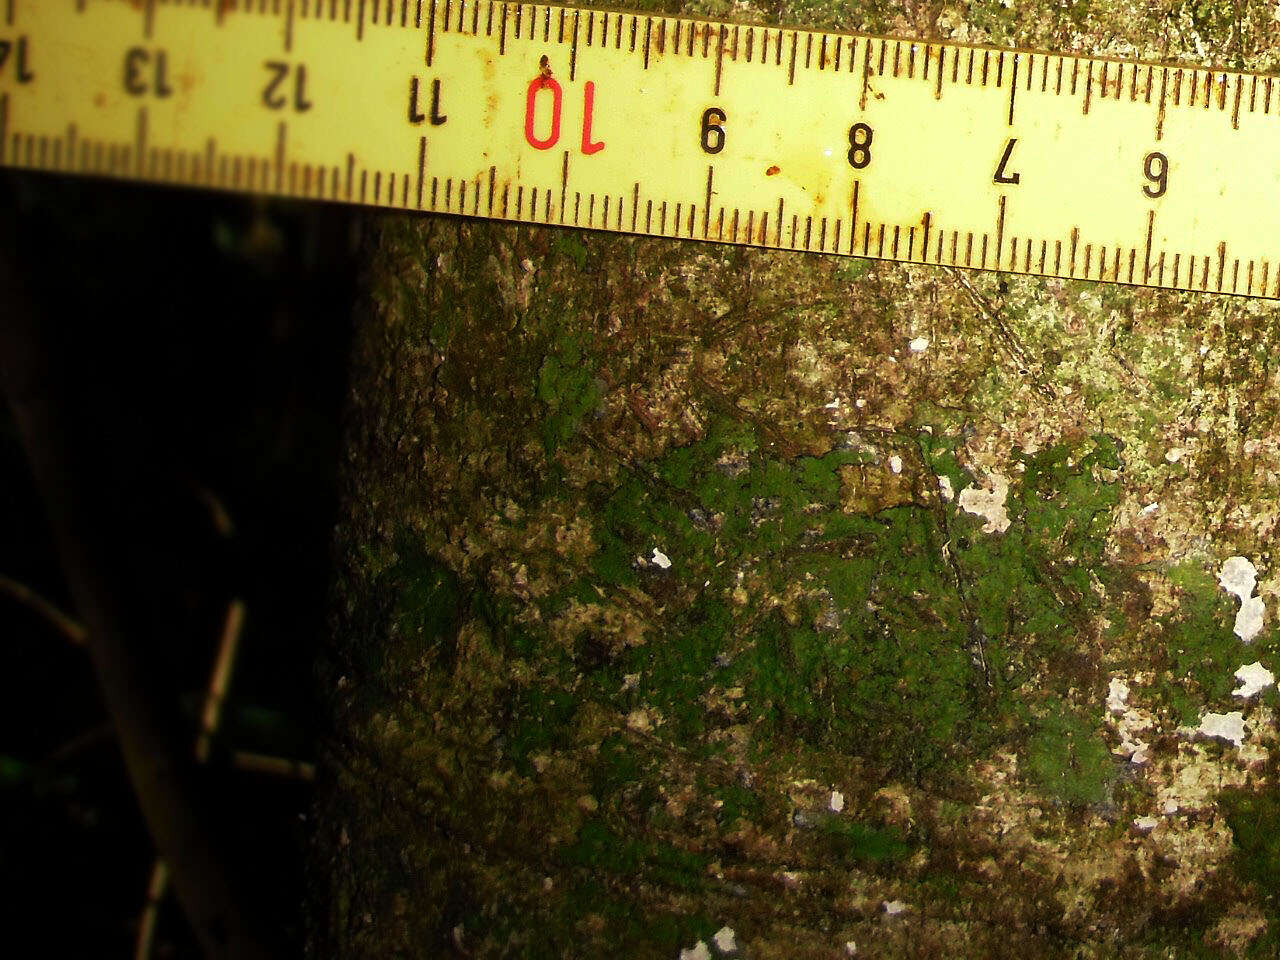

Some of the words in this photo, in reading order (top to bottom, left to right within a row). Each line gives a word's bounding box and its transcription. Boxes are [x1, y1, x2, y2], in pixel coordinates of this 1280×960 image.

[123, 47, 174, 98] 13
[261, 61, 313, 113] 12
[408, 75, 447, 126] 11
[524, 75, 605, 155] 10
[700, 107, 727, 155] 9
[847, 122, 874, 169] 8
[993, 138, 1020, 185] 7
[1142, 152, 1170, 199] 6
